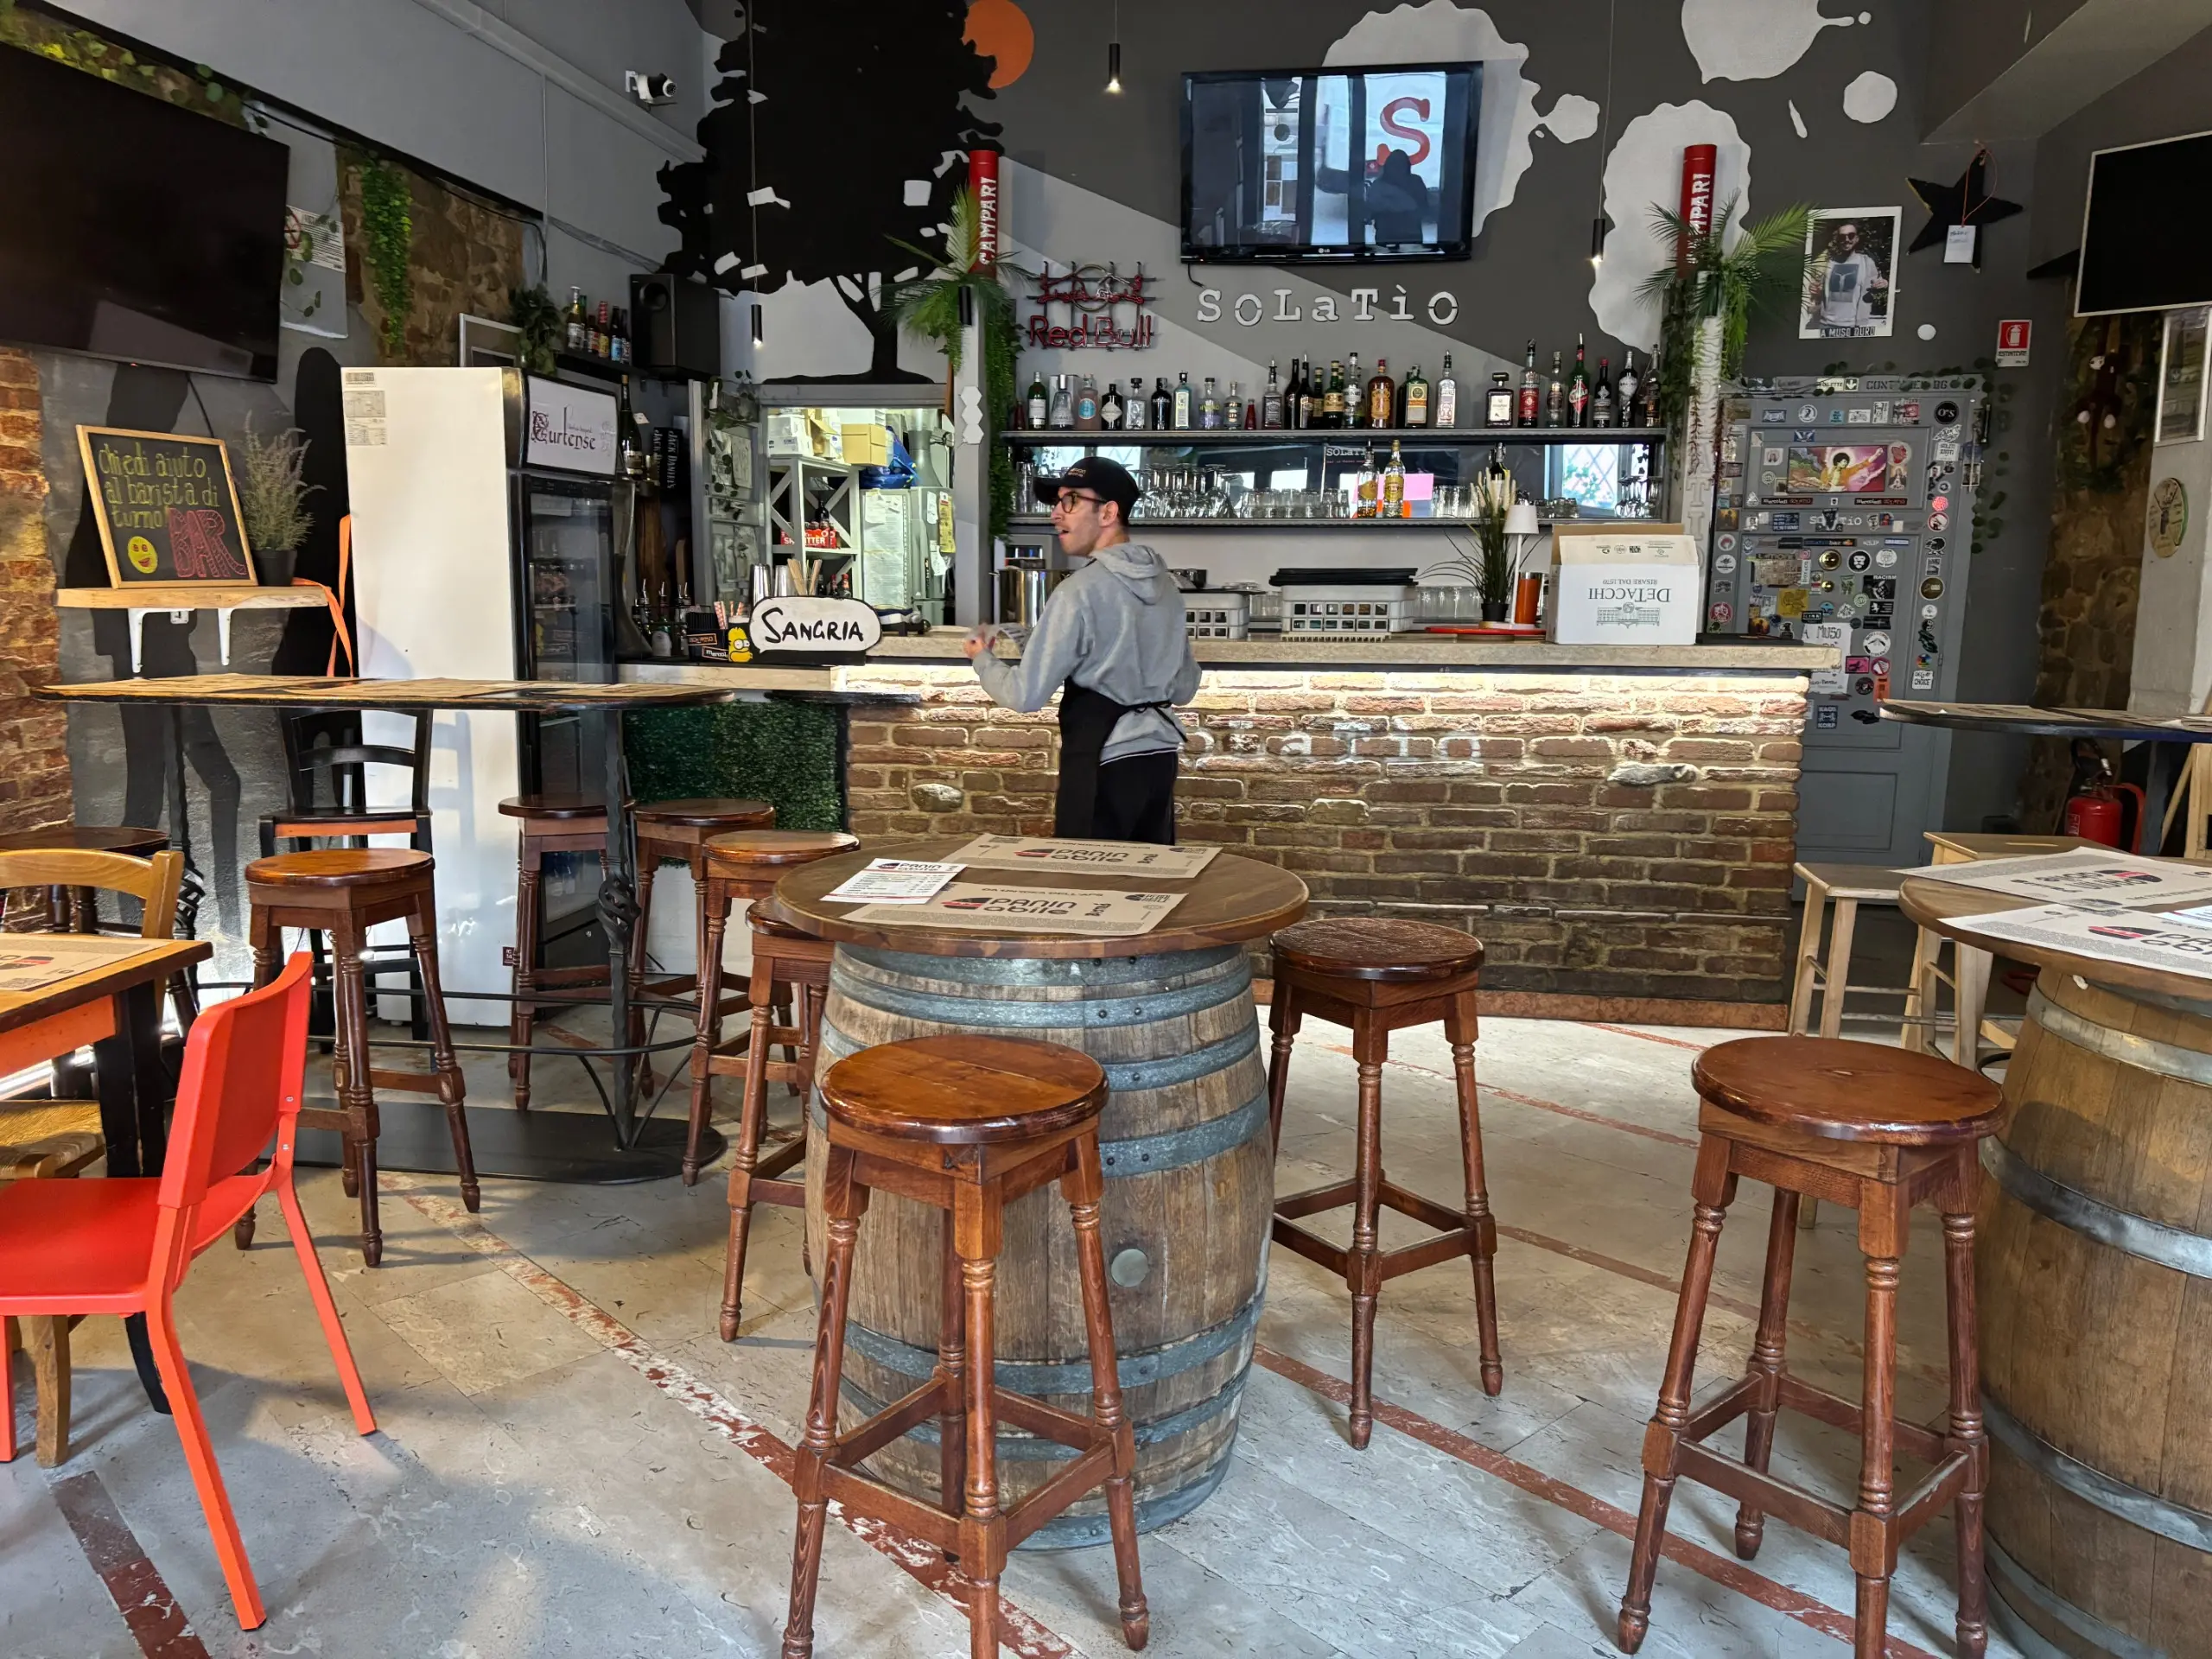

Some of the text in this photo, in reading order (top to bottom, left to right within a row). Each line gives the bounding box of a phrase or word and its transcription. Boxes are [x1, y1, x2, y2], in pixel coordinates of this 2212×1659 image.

[979, 176, 997, 265] CAMPARI
[1686, 174, 1712, 264] MPARI
[1029, 314, 1152, 347] Red Bull
[1820, 327, 1876, 337] A MUSO DURO
[105, 476, 220, 507] al barista di
[761, 607, 864, 644] SANGRIA
[983, 905, 1069, 915] abile
